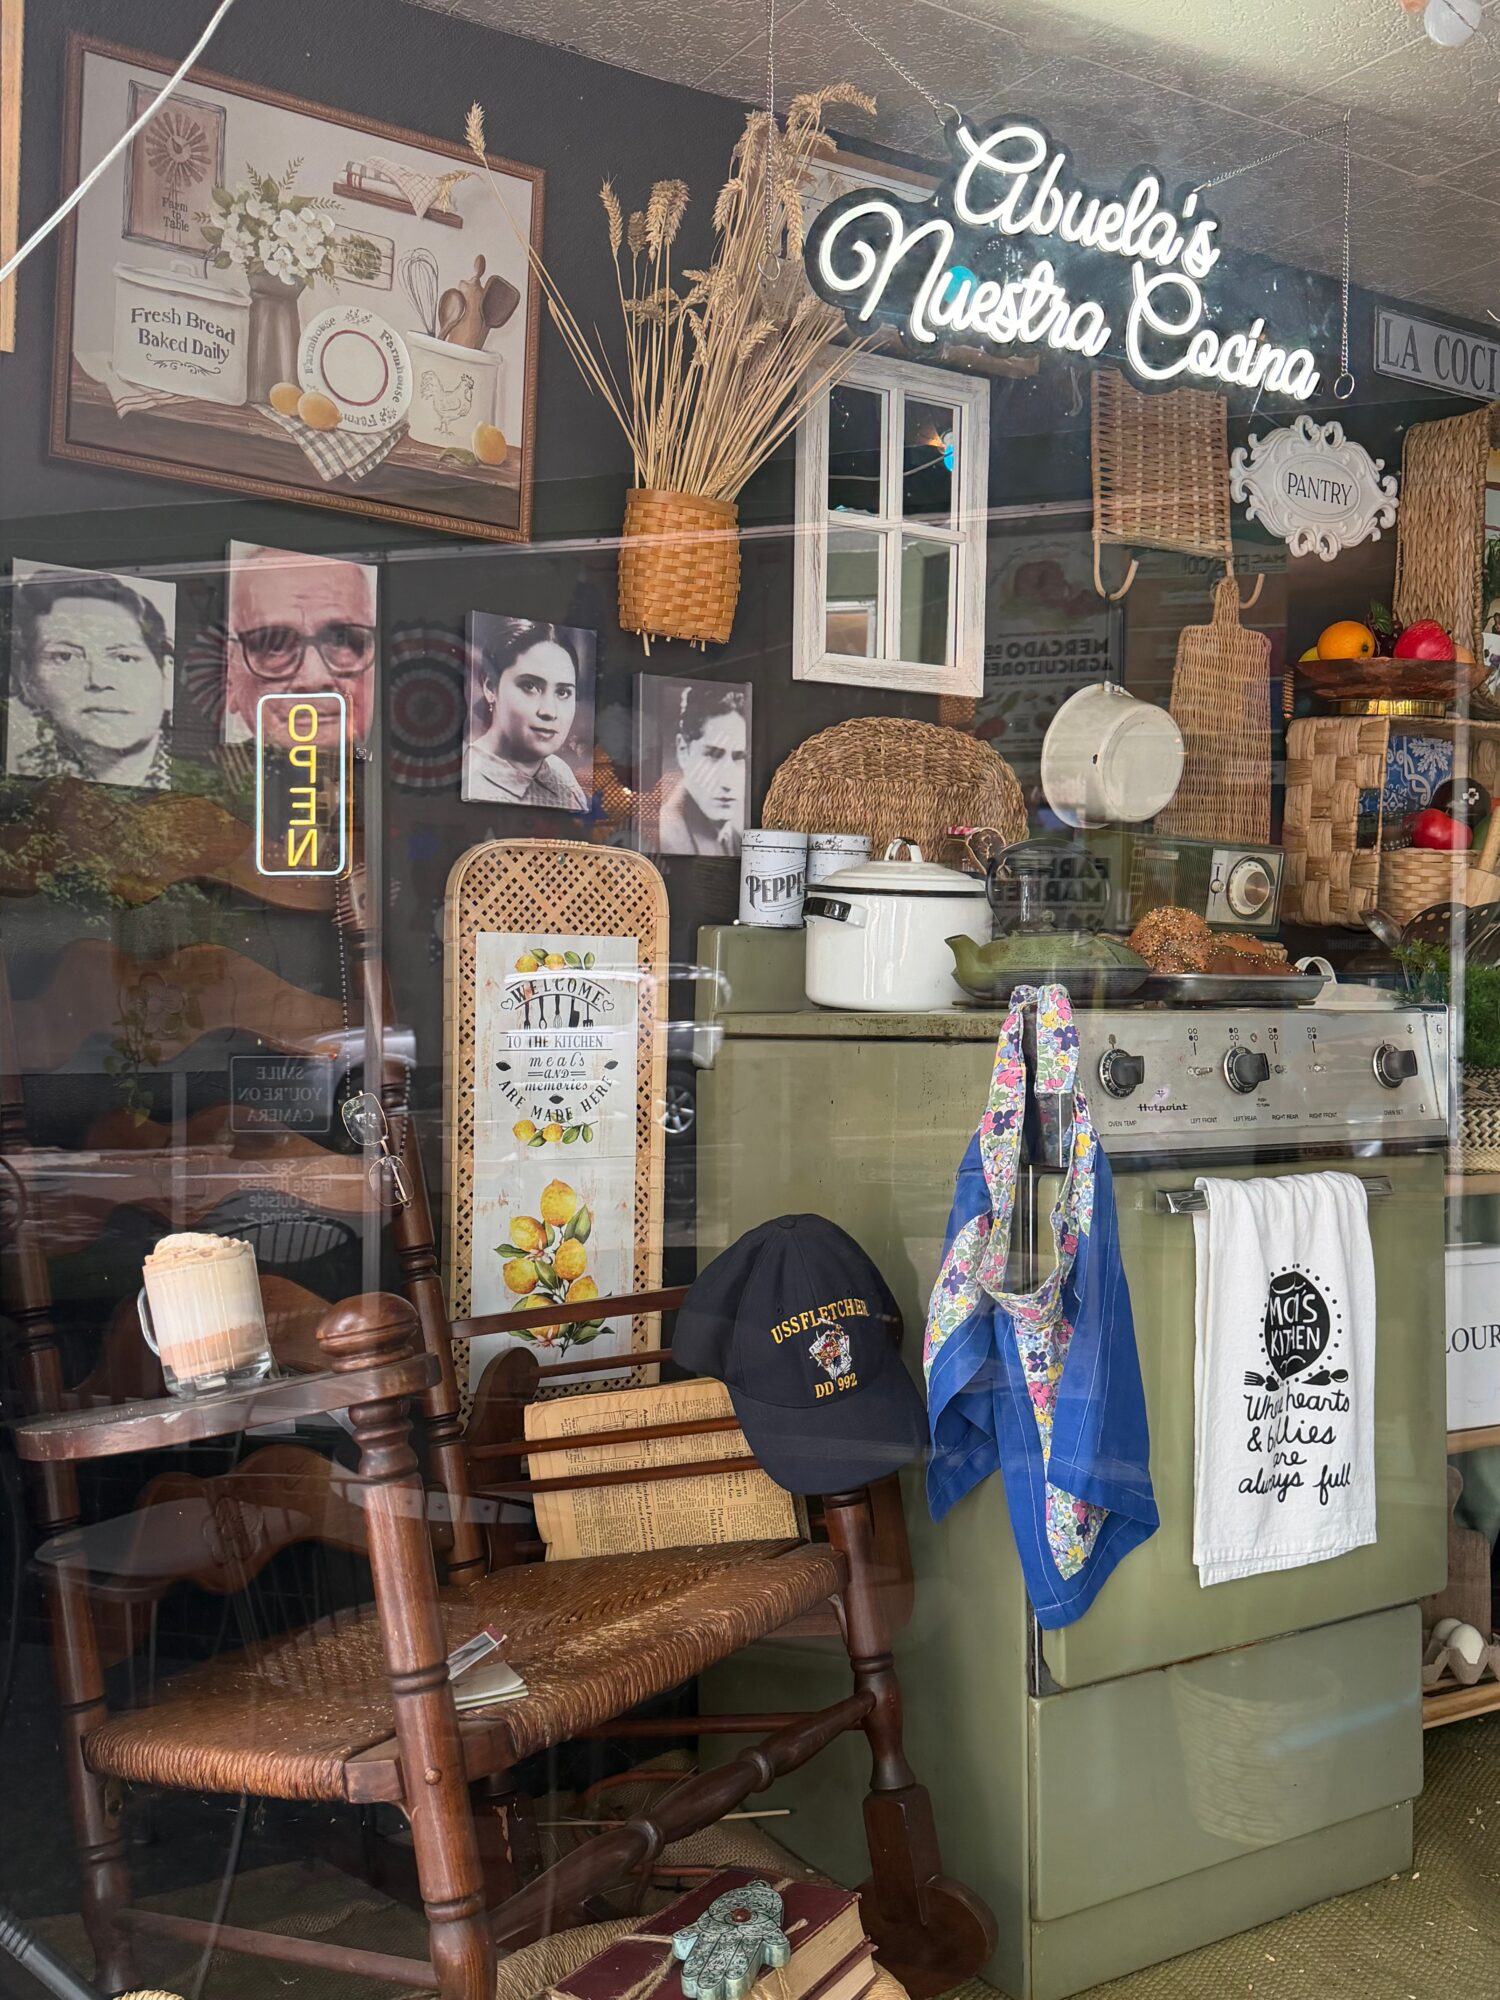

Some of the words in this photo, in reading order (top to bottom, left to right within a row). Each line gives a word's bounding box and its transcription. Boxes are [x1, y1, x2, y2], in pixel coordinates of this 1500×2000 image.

[161, 197, 188, 213] Farm
[171, 209, 182, 221] to
[955, 124, 1221, 280] Abuela's
[163, 216, 190, 232] Table
[818, 201, 1112, 356] Nuestra
[1127, 260, 1322, 401] Cocina
[130, 307, 181, 325] Fresh
[186, 311, 236, 345] Bread
[138, 327, 188, 353] Baked
[191, 338, 230, 364] Daily
[304, 317, 336, 374] Farmhouse
[1381, 317, 1422, 373] LA
[1434, 333, 1500, 395] COCI
[379, 329, 404, 403] Farmhouse
[340, 413, 378, 427] Farm
[1287, 472, 1353, 507] PANTRY
[745, 870, 805, 910] PEPPE
[510, 977, 605, 1007] WELCOME
[506, 1035, 522, 1049] TO
[528, 1035, 549, 1048] THE
[554, 1035, 604, 1048] KITCHEN
[529, 1052, 585, 1067] meals
[543, 1068, 570, 1079] AND
[498, 1080, 527, 1110] ARE
[530, 1105, 574, 1122] MADE
[580, 1074, 614, 1113] HERE
[525, 1079, 588, 1092] memories
[1124, 1119, 1137, 1127] TEMP
[1137, 1103, 1188, 1113] Hotpoint
[1271, 1325, 1320, 1357] KITHEN
[1445, 1324, 1500, 1353] OUR
[814, 1381, 834, 1399] DD
[837, 1372, 858, 1392] 992
[1285, 1387, 1350, 1412] hearts
[1247, 1426, 1263, 1452] &
[1267, 1415, 1337, 1453] bllies
[1312, 1462, 1351, 1506] full
